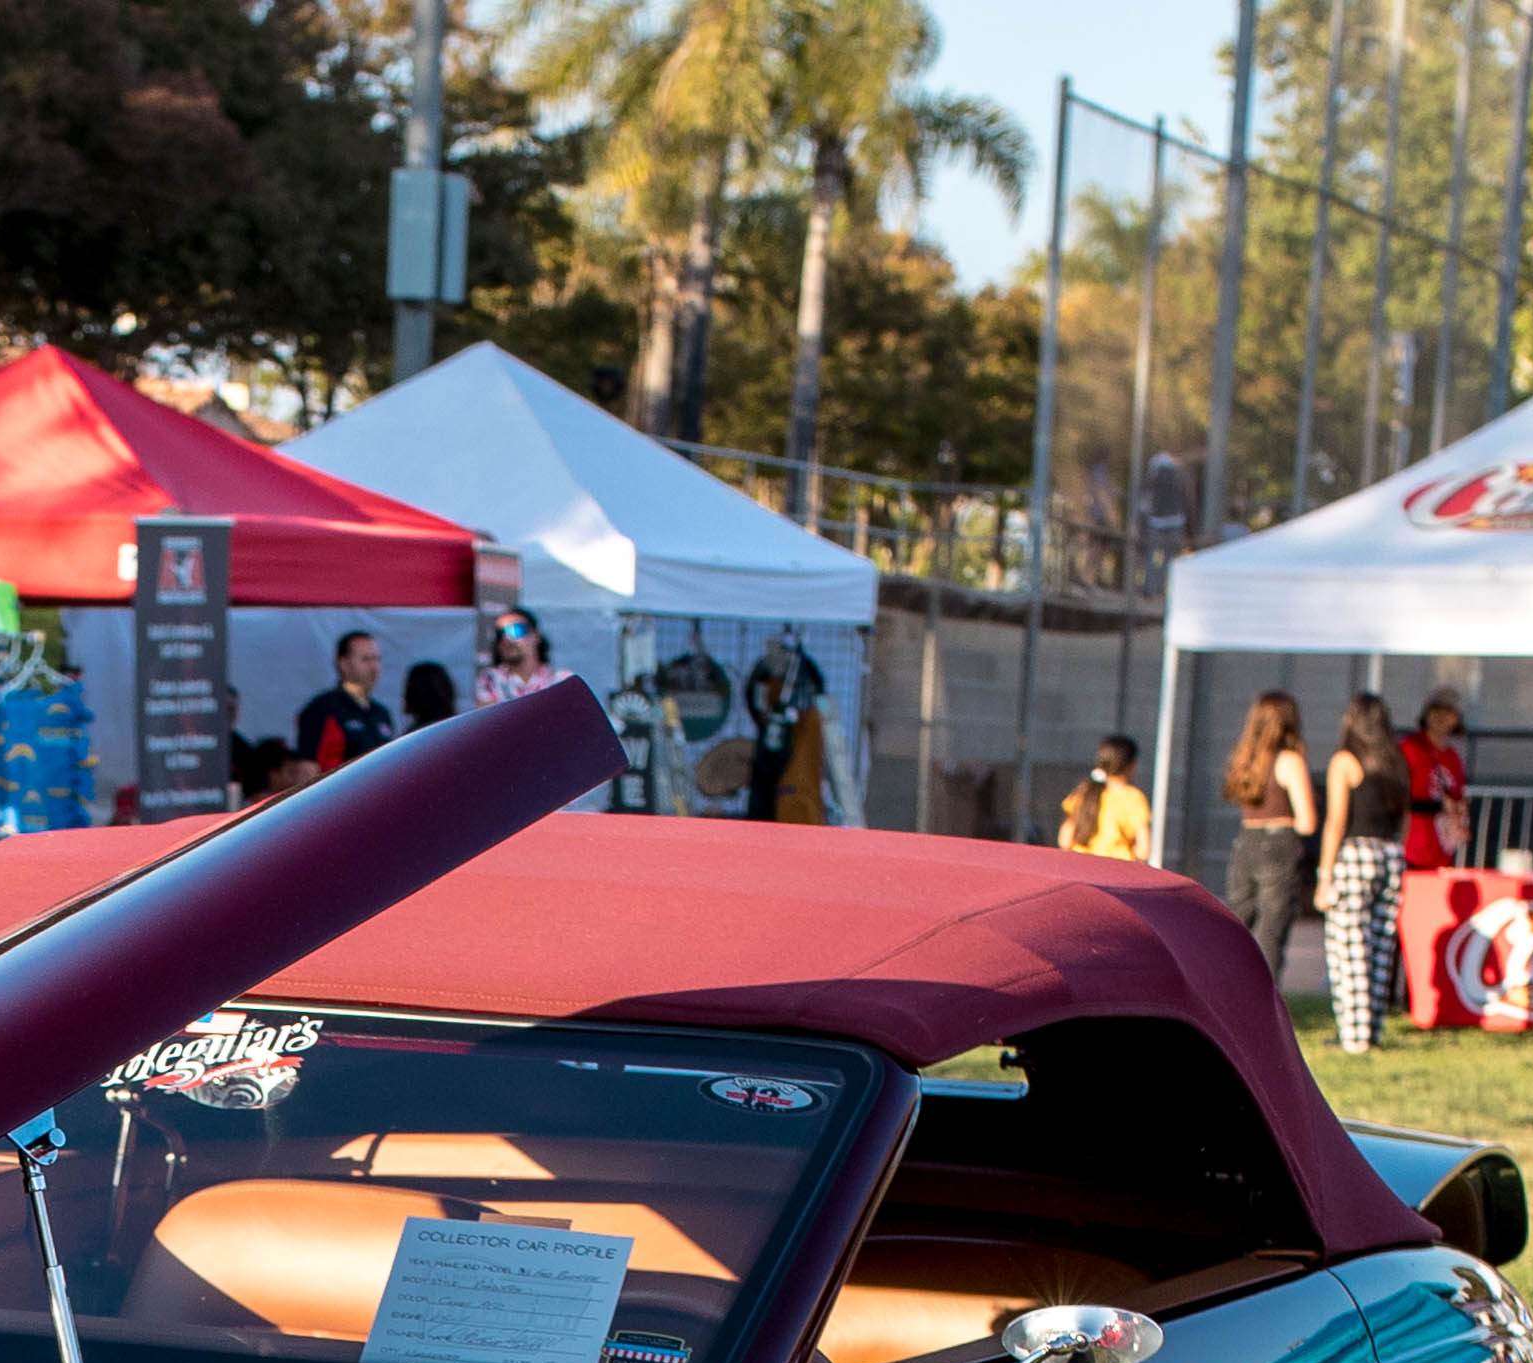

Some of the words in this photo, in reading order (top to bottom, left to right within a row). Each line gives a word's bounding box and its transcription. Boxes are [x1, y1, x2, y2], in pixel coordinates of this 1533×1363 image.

[417, 1230, 511, 1249] COLLECTOR
[516, 1239, 547, 1252] CAR
[552, 1242, 619, 1260] PROFILE
[482, 1265, 512, 1275] MODEL
